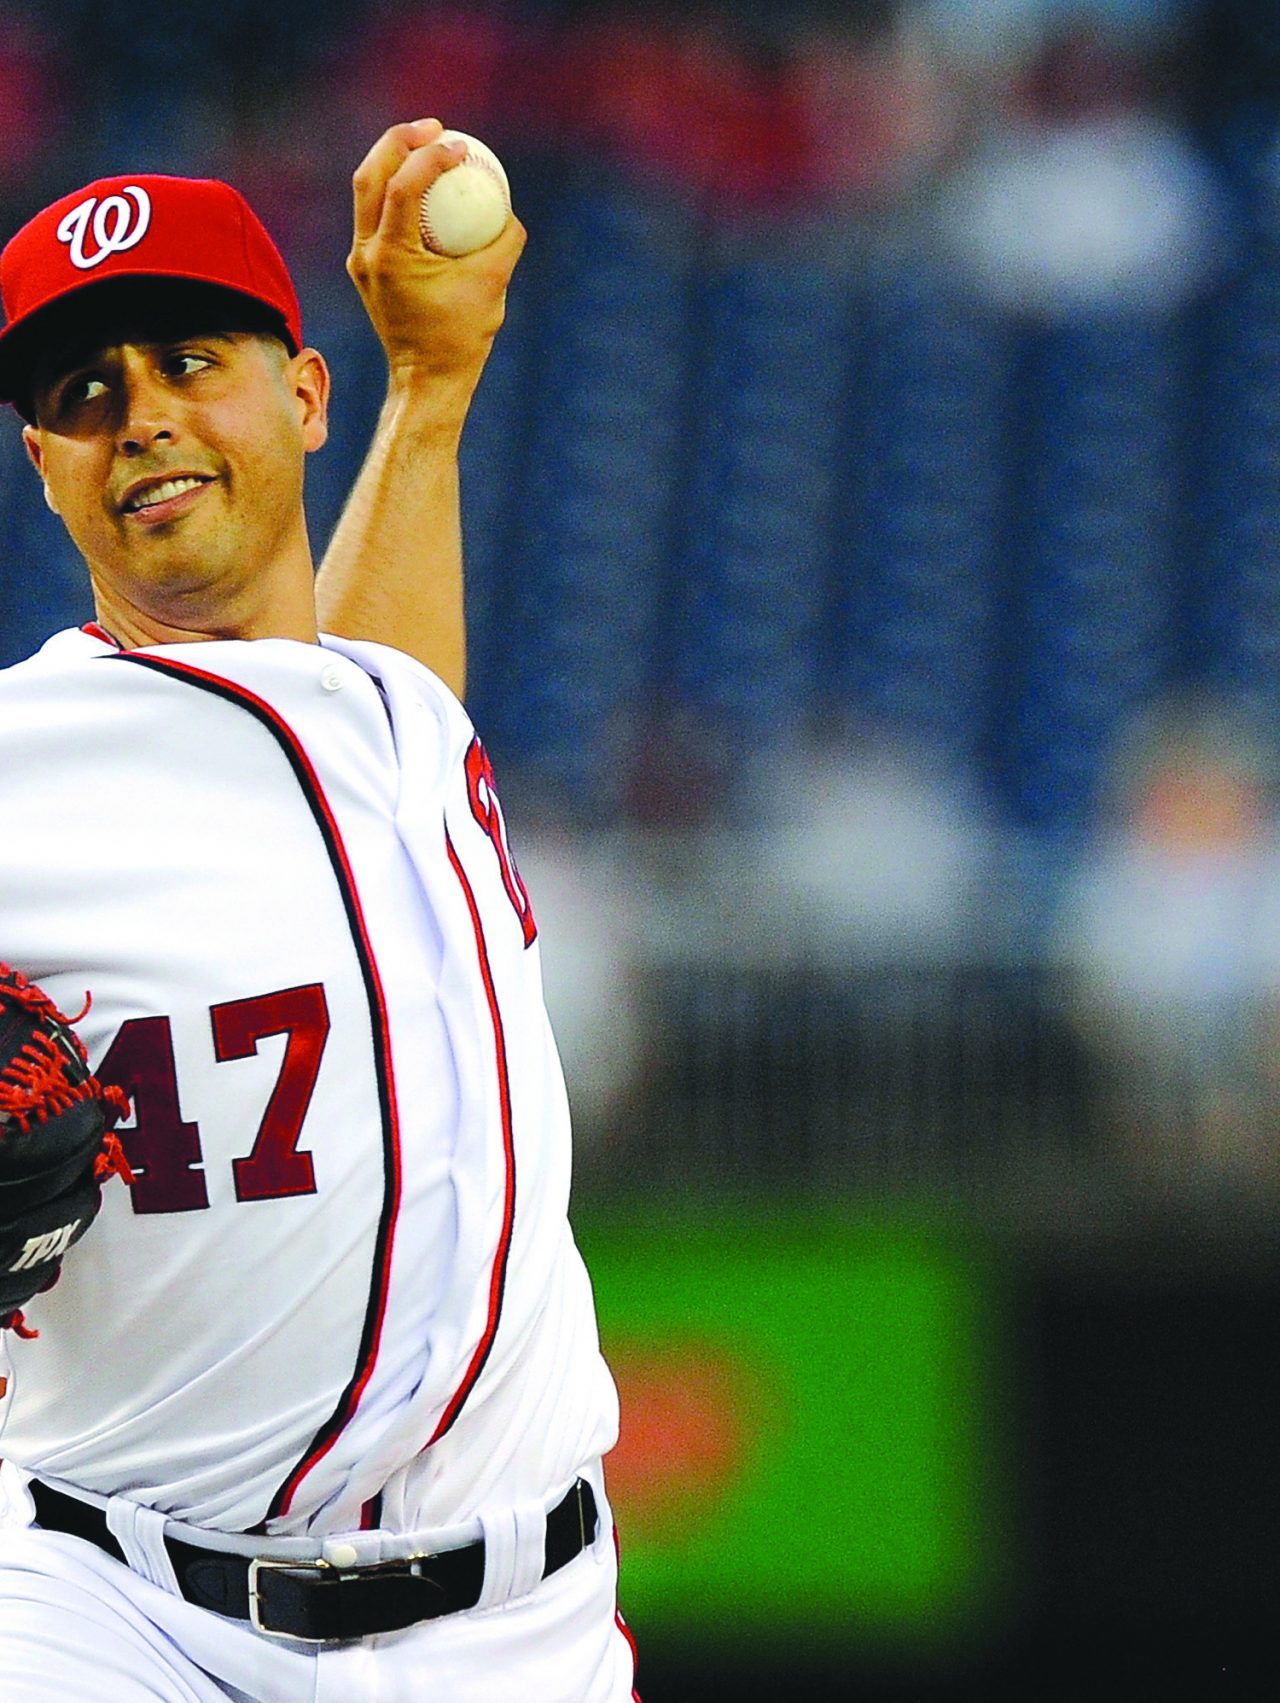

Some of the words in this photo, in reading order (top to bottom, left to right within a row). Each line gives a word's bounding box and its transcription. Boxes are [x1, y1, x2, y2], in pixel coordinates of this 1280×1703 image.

[56, 185, 151, 269] W
[93, 981, 331, 1214] 47
[8, 1218, 81, 1272] TPX
